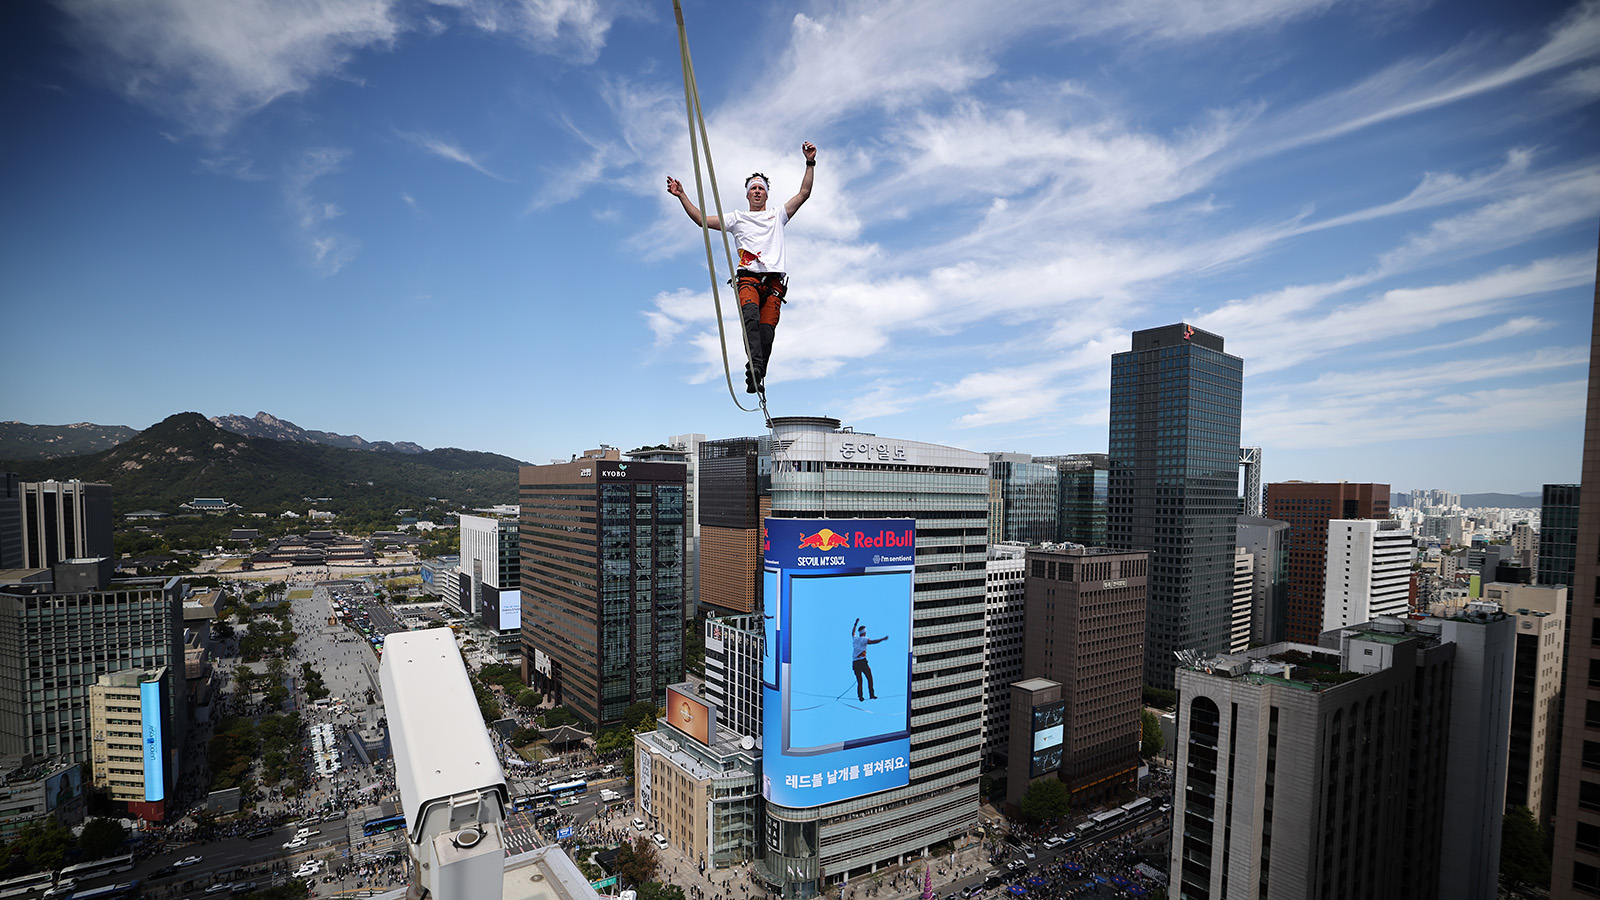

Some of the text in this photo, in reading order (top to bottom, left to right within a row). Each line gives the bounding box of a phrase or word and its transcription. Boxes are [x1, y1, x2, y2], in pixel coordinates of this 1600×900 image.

[839, 441, 907, 461] 동아일보
[602, 470, 626, 478] KYOBO
[854, 530, 913, 548] Red Bull
[797, 556, 819, 566] SEOUL
[820, 556, 829, 566] MY
[889, 554, 912, 562] sentient
[785, 756, 908, 789] 레드불 날개를 펼쳐줘요.
